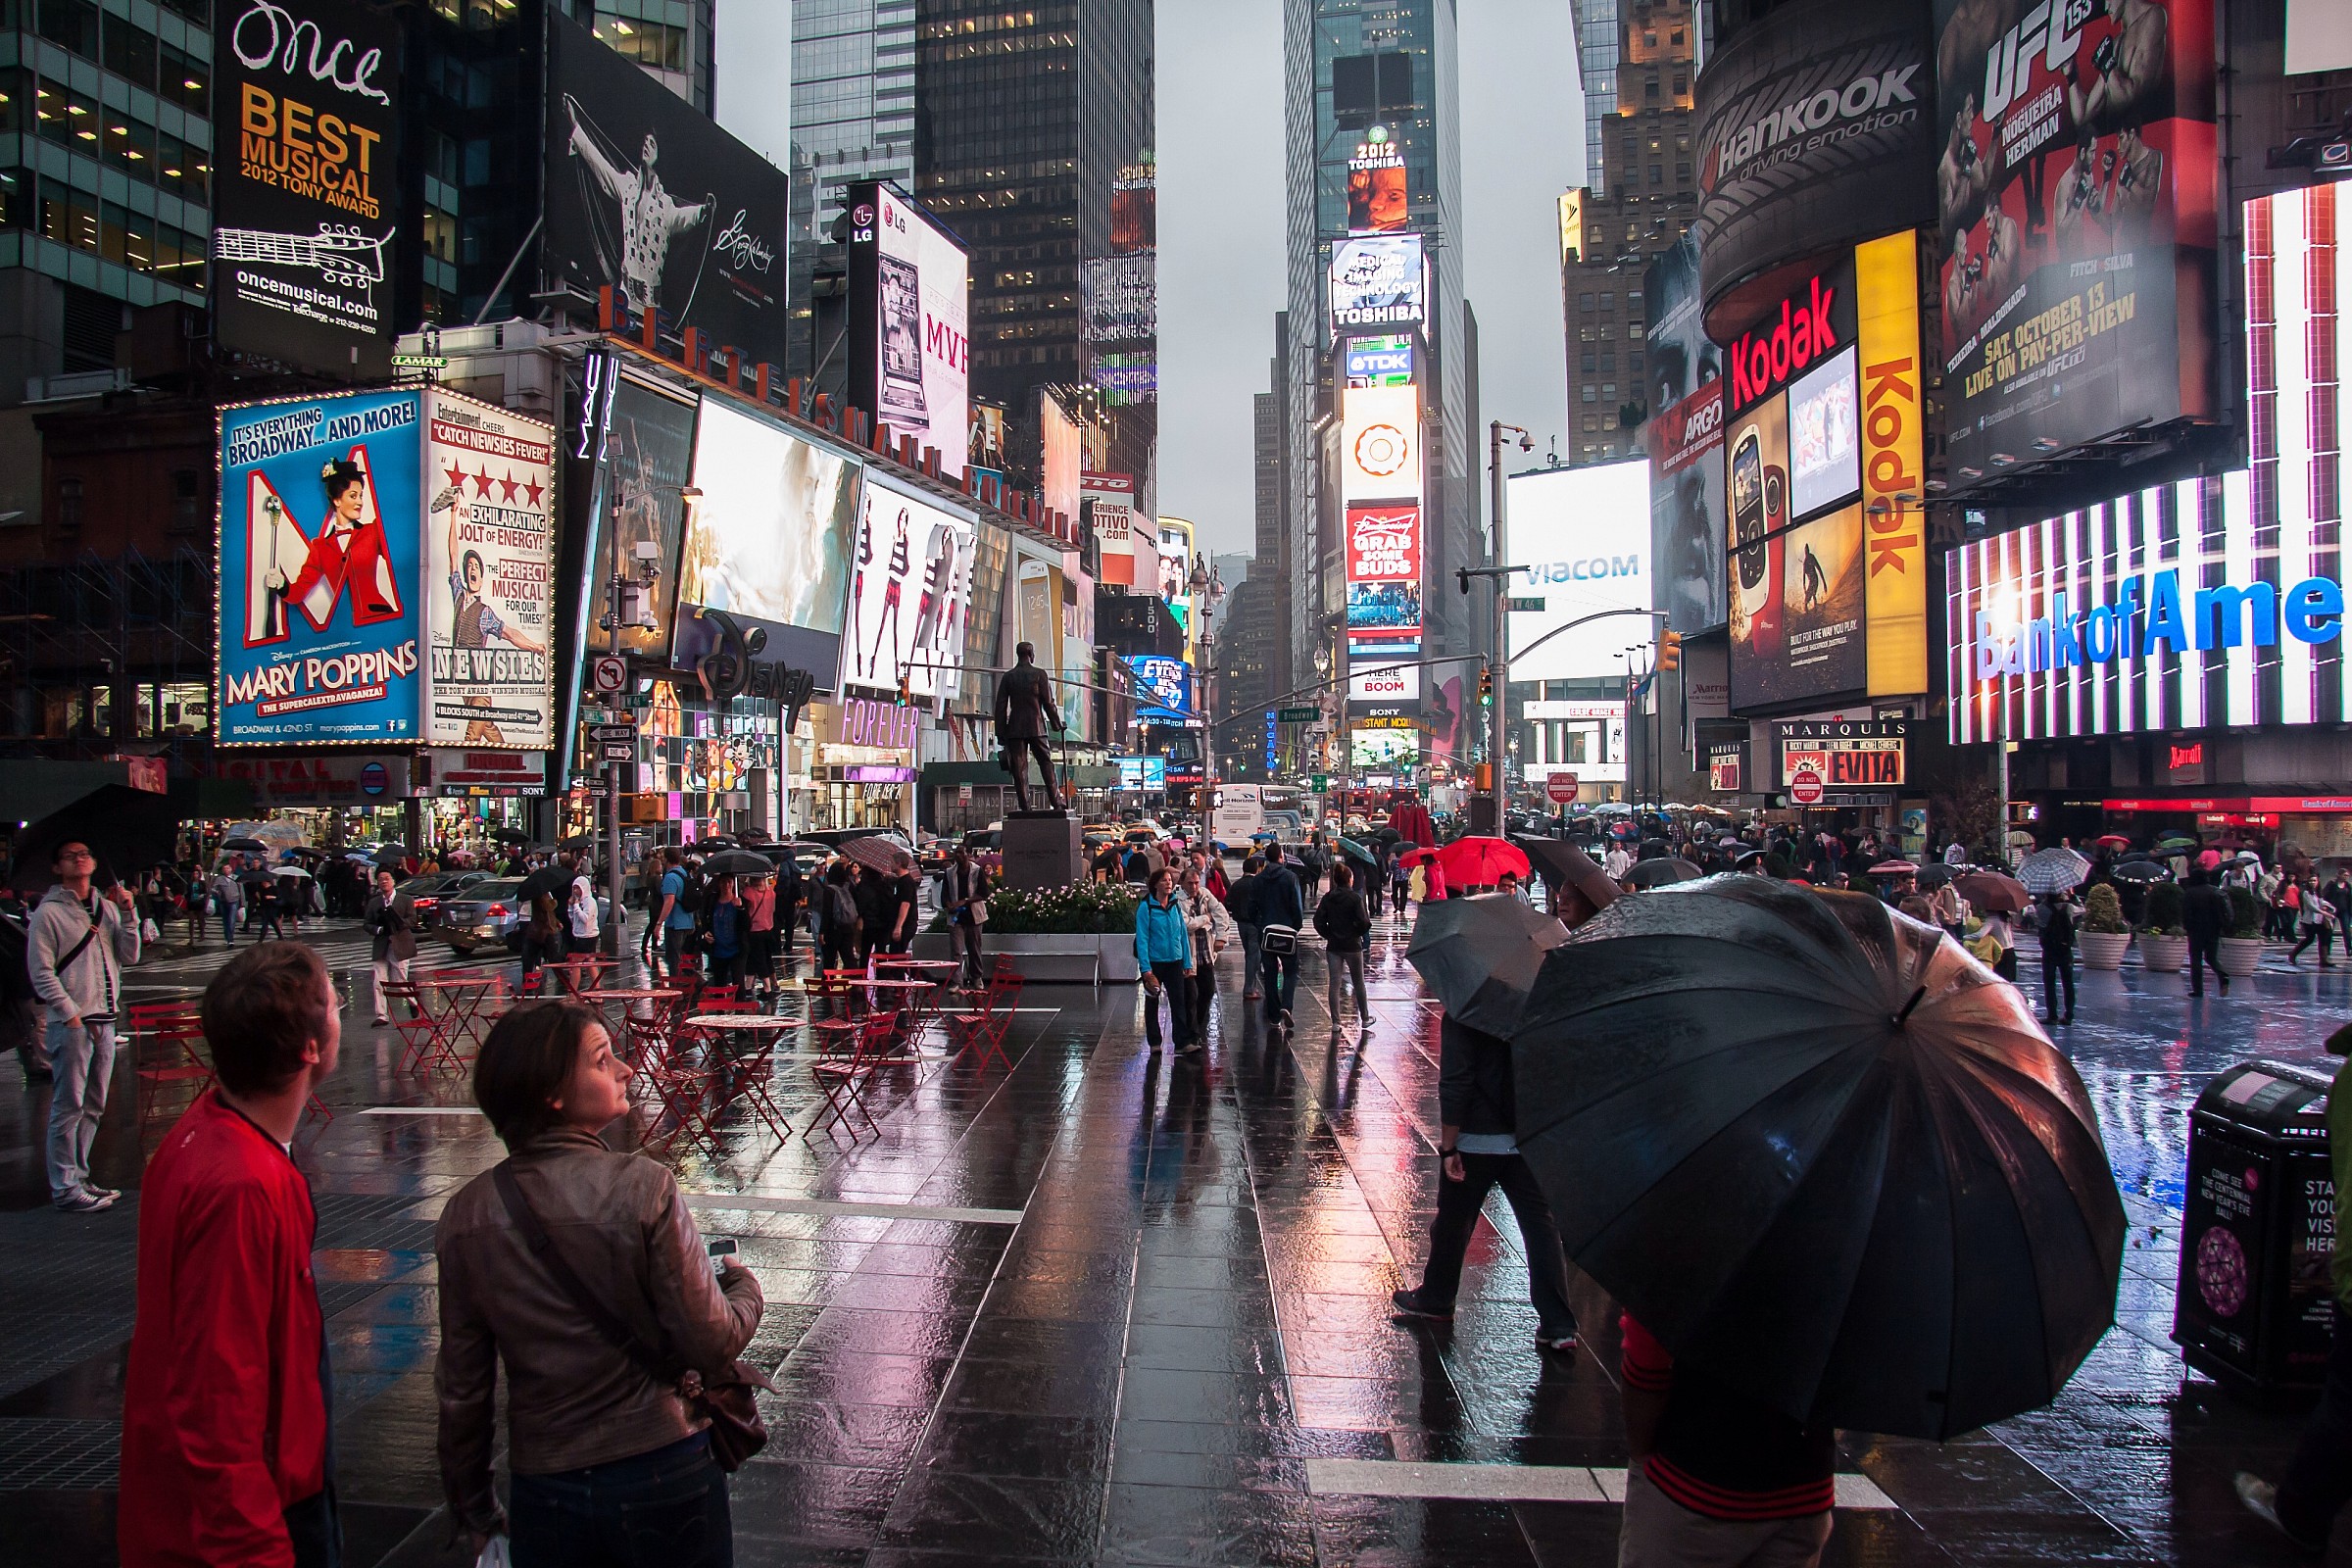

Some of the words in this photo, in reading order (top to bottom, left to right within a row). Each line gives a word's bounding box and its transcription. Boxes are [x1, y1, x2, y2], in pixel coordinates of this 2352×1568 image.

[2066, 0, 2092, 31] 153
[1983, 0, 2082, 122] UFC
[242, 81, 380, 174] BEST
[2001, 85, 2062, 147] NOGUEIRA
[1357, 144, 1396, 159] 2012
[1740, 142, 1802, 182] driving
[1806, 108, 1917, 150] emotion
[2005, 113, 2059, 170] HERMAN
[241, 131, 379, 205] MUSICAL
[1348, 156, 1404, 170] TOSHIBA
[241, 161, 277, 187] 2012
[280, 172, 322, 202] TONY
[325, 190, 379, 219] AWARD
[854, 228, 873, 242] LG
[895, 213, 906, 234] LG
[1348, 252, 1406, 269] MEDICAL
[2070, 260, 2097, 278] FITCH
[2103, 253, 2133, 272] SILVA
[1334, 280, 1420, 297] TECHNOLOGY
[1347, 269, 1404, 282] IMAGING
[236, 270, 377, 320] oncemusical.com
[1335, 305, 1423, 324] TOSHIBA
[2015, 294, 2082, 350] OCTOBER
[2087, 281, 2104, 312] 13
[1946, 335, 1978, 373] TEIXEIRA
[1980, 283, 2027, 339] MALDONADO
[1731, 275, 1838, 411] Kodak
[1965, 365, 1993, 398] LIVE
[1996, 352, 2016, 382] ON
[2020, 292, 2135, 371] PAY-PER-VIEW
[394, 358, 444, 367] LAMAR
[1365, 354, 1408, 369] TDK
[599, 283, 942, 481] BERTELSMANN
[232, 425, 252, 444] IT'S
[254, 408, 322, 438] EVERYTHING
[438, 403, 481, 429] Entertainment
[482, 420, 505, 434] CHEERS
[1683, 399, 1723, 446] ARGO
[228, 425, 325, 466] BROADWAY...
[328, 415, 362, 442] AND
[364, 401, 416, 434] MORE!
[470, 430, 515, 456] NEWSIES
[1866, 356, 1918, 578] Kodak
[459, 507, 469, 518] AN
[471, 505, 545, 531] EXHILARATING
[962, 465, 1085, 548] BUILDING
[459, 522, 484, 543] JOLT
[486, 530, 496, 542] OF
[1102, 529, 1129, 541] .com
[1354, 535, 1412, 551] GRAB
[1355, 560, 1412, 576] BUDS
[1362, 550, 1404, 562] SOME
[500, 560, 546, 581] PERFECT
[492, 579, 544, 601] MUSICAL
[506, 600, 520, 612] FOR
[521, 601, 537, 612] OUR
[1147, 597, 1155, 634] 1500
[1515, 599, 1523, 609] W
[1525, 599, 1535, 610] 46
[1789, 633, 1802, 646] BUILT
[1803, 631, 1812, 642] FOR
[1812, 628, 1822, 640] THE
[1822, 625, 1833, 638] WAY
[1833, 622, 1843, 635] YOU
[1844, 619, 1857, 632] PLAY.
[1976, 592, 2082, 681] Bank
[2085, 575, 2136, 663] of
[2143, 568, 2344, 657] Ame
[226, 661, 300, 704] MARY
[307, 639, 418, 689] POPPINS
[432, 647, 545, 681] NEWSIES
[1369, 668, 1399, 677] HERE
[1365, 682, 1404, 691] BOOM
[263, 703, 277, 713] THE
[278, 687, 383, 710] SUPERCALEXTRAVAGANZA!
[440, 706, 462, 715] BLOCKS
[462, 708, 479, 717] SOUTH
[841, 697, 920, 750] FOREVER
[1284, 711, 1313, 720] Broadway
[233, 725, 274, 734] BROADWAY
[319, 723, 379, 735] marypoppins.com
[1782, 723, 1905, 736] MARQUIS
[1709, 744, 1740, 754] MARQUIS
[1789, 741, 1802, 751] RICKY
[1859, 740, 1877, 750] MICHAEL
[2169, 743, 2201, 769] Marriott
[1832, 752, 1898, 783] EVITA
[494, 786, 517, 795] Canon
[2202, 1176, 2214, 1188] THE
[2214, 1181, 2251, 1204] CENTENNIAL
[2211, 1168, 2229, 1184] COME
[2230, 1176, 2242, 1189] SEE
[2201, 1188, 2215, 1200] NEW
[2216, 1194, 2237, 1210] YEAR'S
[2238, 1204, 2250, 1216] EVE
